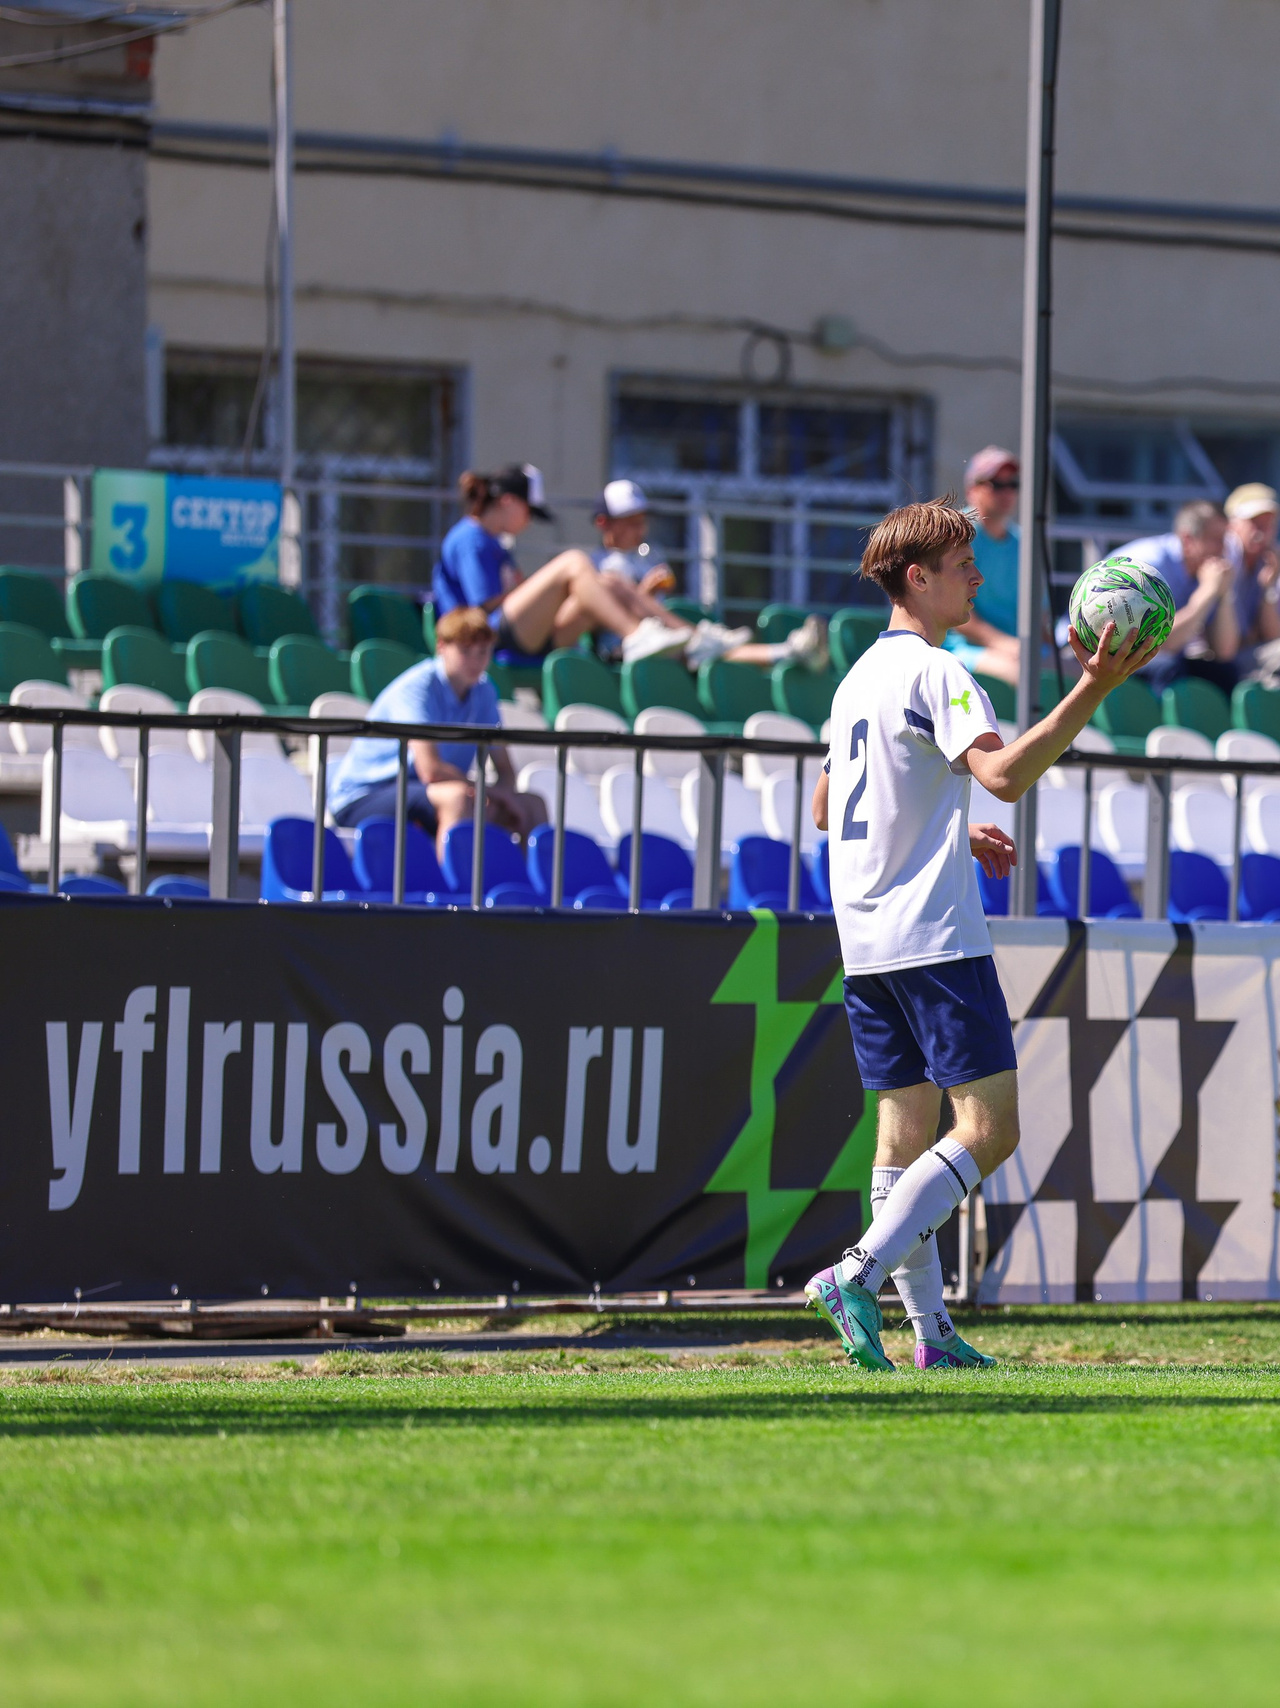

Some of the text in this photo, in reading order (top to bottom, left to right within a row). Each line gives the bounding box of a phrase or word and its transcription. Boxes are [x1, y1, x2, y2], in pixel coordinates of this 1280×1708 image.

[110, 504, 147, 572] 3
[841, 719, 868, 840] 2
[46, 985, 663, 1210] yflrussia.ru
